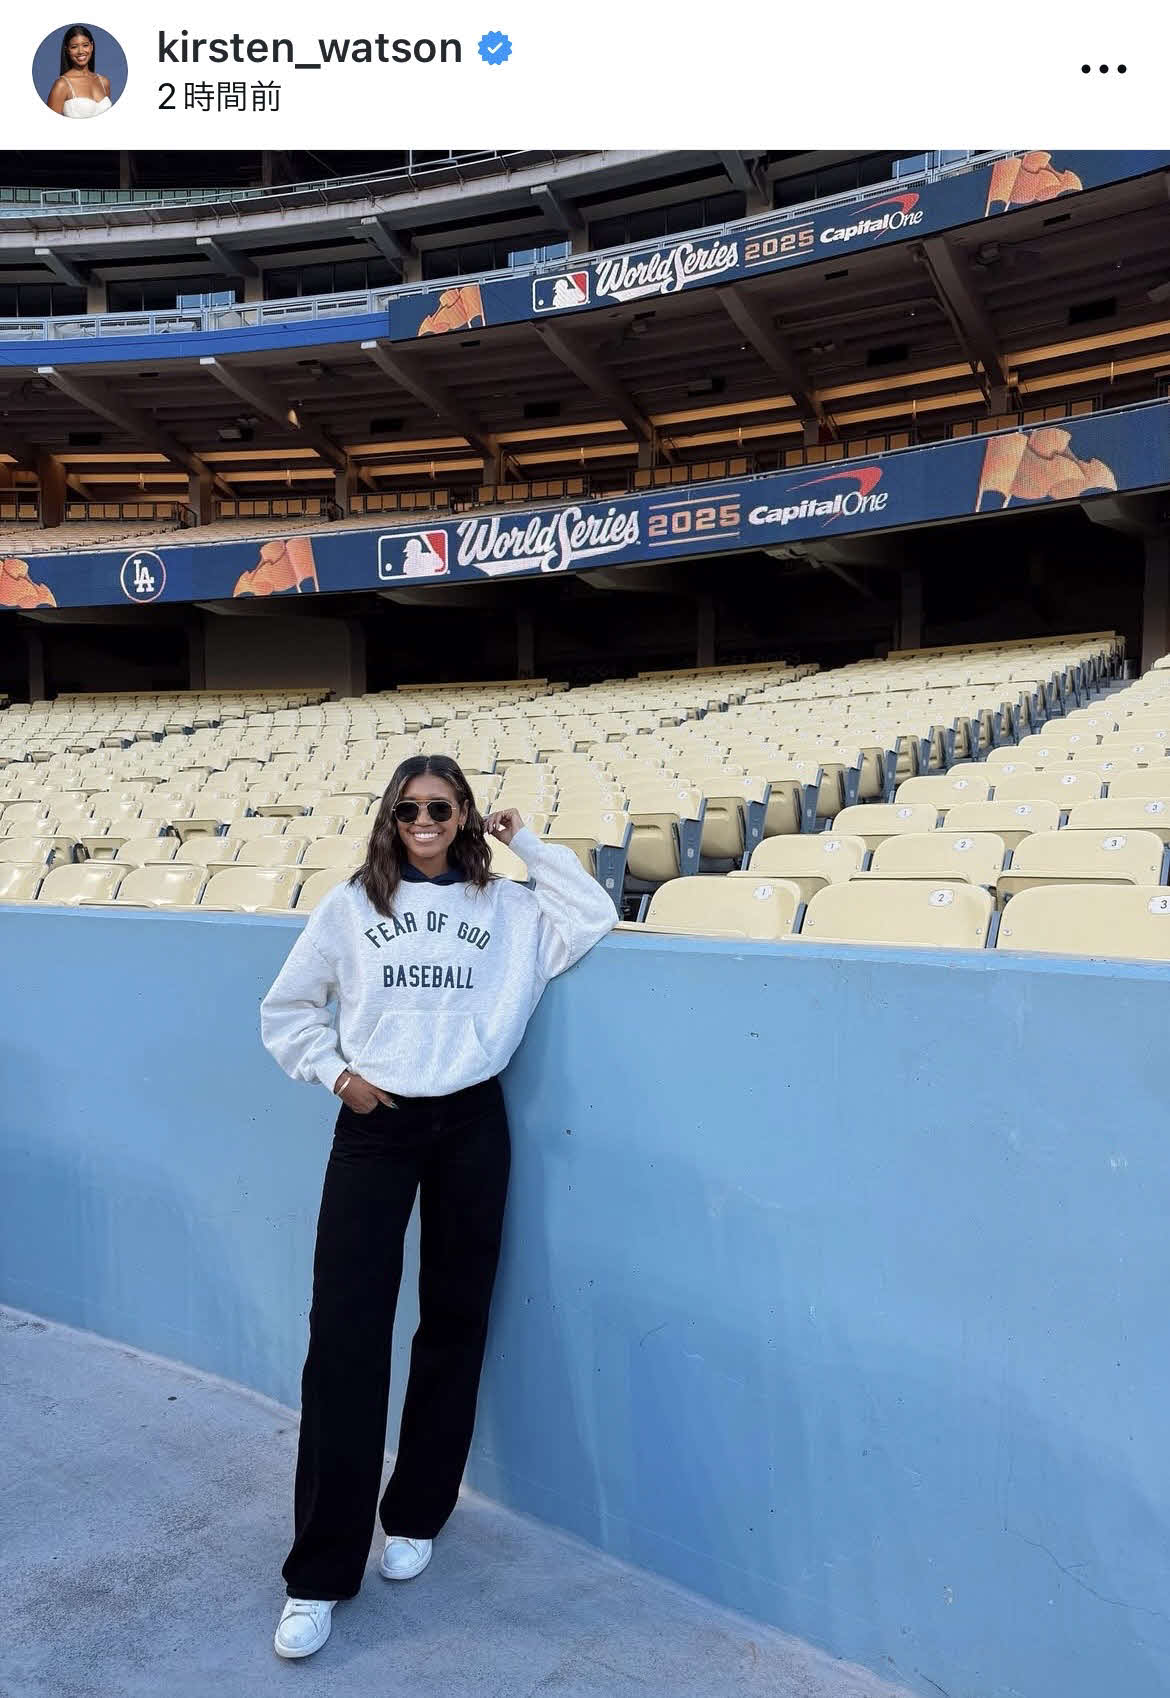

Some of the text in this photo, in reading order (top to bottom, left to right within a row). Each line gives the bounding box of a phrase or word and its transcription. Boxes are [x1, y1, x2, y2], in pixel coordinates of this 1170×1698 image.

[595, 248, 677, 297] World
[661, 241, 738, 295] Series
[744, 229, 815, 262] 2025
[456, 513, 562, 567] World
[540, 506, 640, 573] Series
[648, 503, 741, 538] 2025
[133, 559, 155, 593] LA
[364, 910, 491, 950] FEAR OF GOD
[383, 964, 474, 989] BASEBALL
